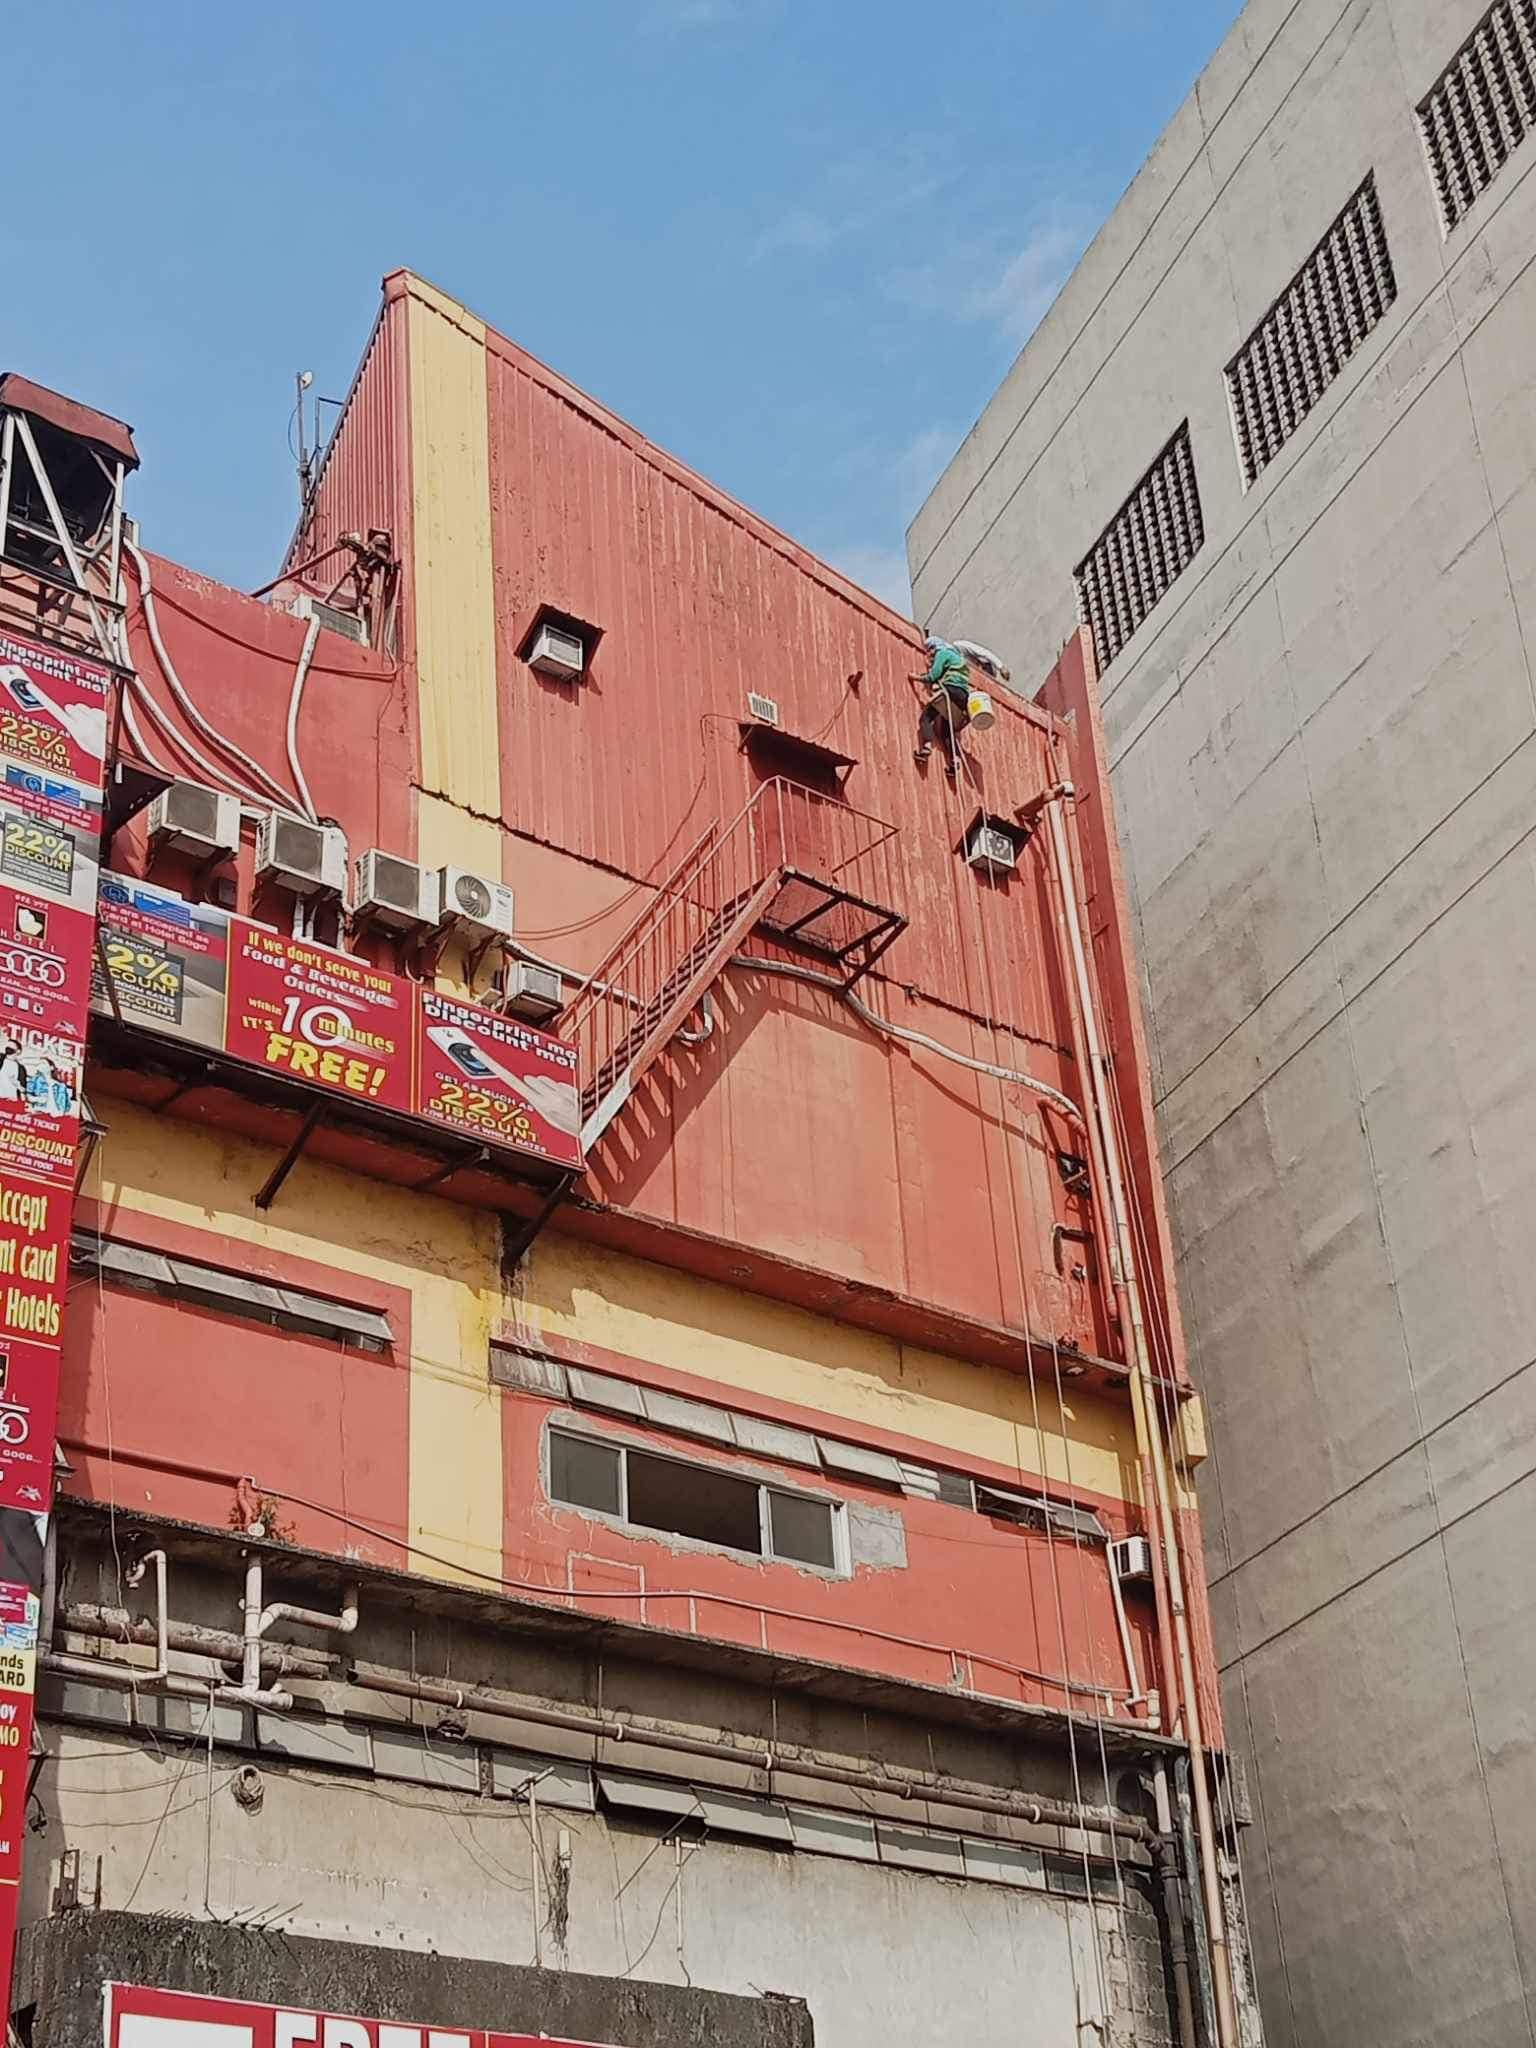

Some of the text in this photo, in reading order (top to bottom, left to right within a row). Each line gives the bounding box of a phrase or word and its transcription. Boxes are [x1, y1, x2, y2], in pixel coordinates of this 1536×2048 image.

[0, 638, 80, 677] ingerprint
[0, 734, 71, 767] ISCOUNT
[1, 716, 66, 755] 22%
[5, 843, 71, 872] DISCOUNT
[6, 823, 72, 864] 22%
[142, 916, 193, 938] accepted
[145, 923, 175, 940] Hotel
[242, 945, 286, 969] Food
[290, 964, 304, 976] &
[249, 931, 392, 993] If we don't serve your
[242, 1015, 274, 1032] IT'S
[248, 997, 395, 1053] within 10 minutes
[422, 992, 541, 1046] Fingerprint
[425, 1004, 529, 1052] Discount
[7, 1023, 84, 1063] TICKET
[266, 1032, 387, 1096] FREE!
[435, 1071, 460, 1086] GET
[463, 1080, 479, 1092] AS
[481, 1086, 516, 1106] MUCH
[440, 1083, 530, 1130] 22%
[429, 1098, 538, 1142] DISCOUNT
[0, 1129, 75, 1158] DISCOUNT
[20, 1243, 58, 1284] card
[5, 1287, 60, 1337] Hotels
